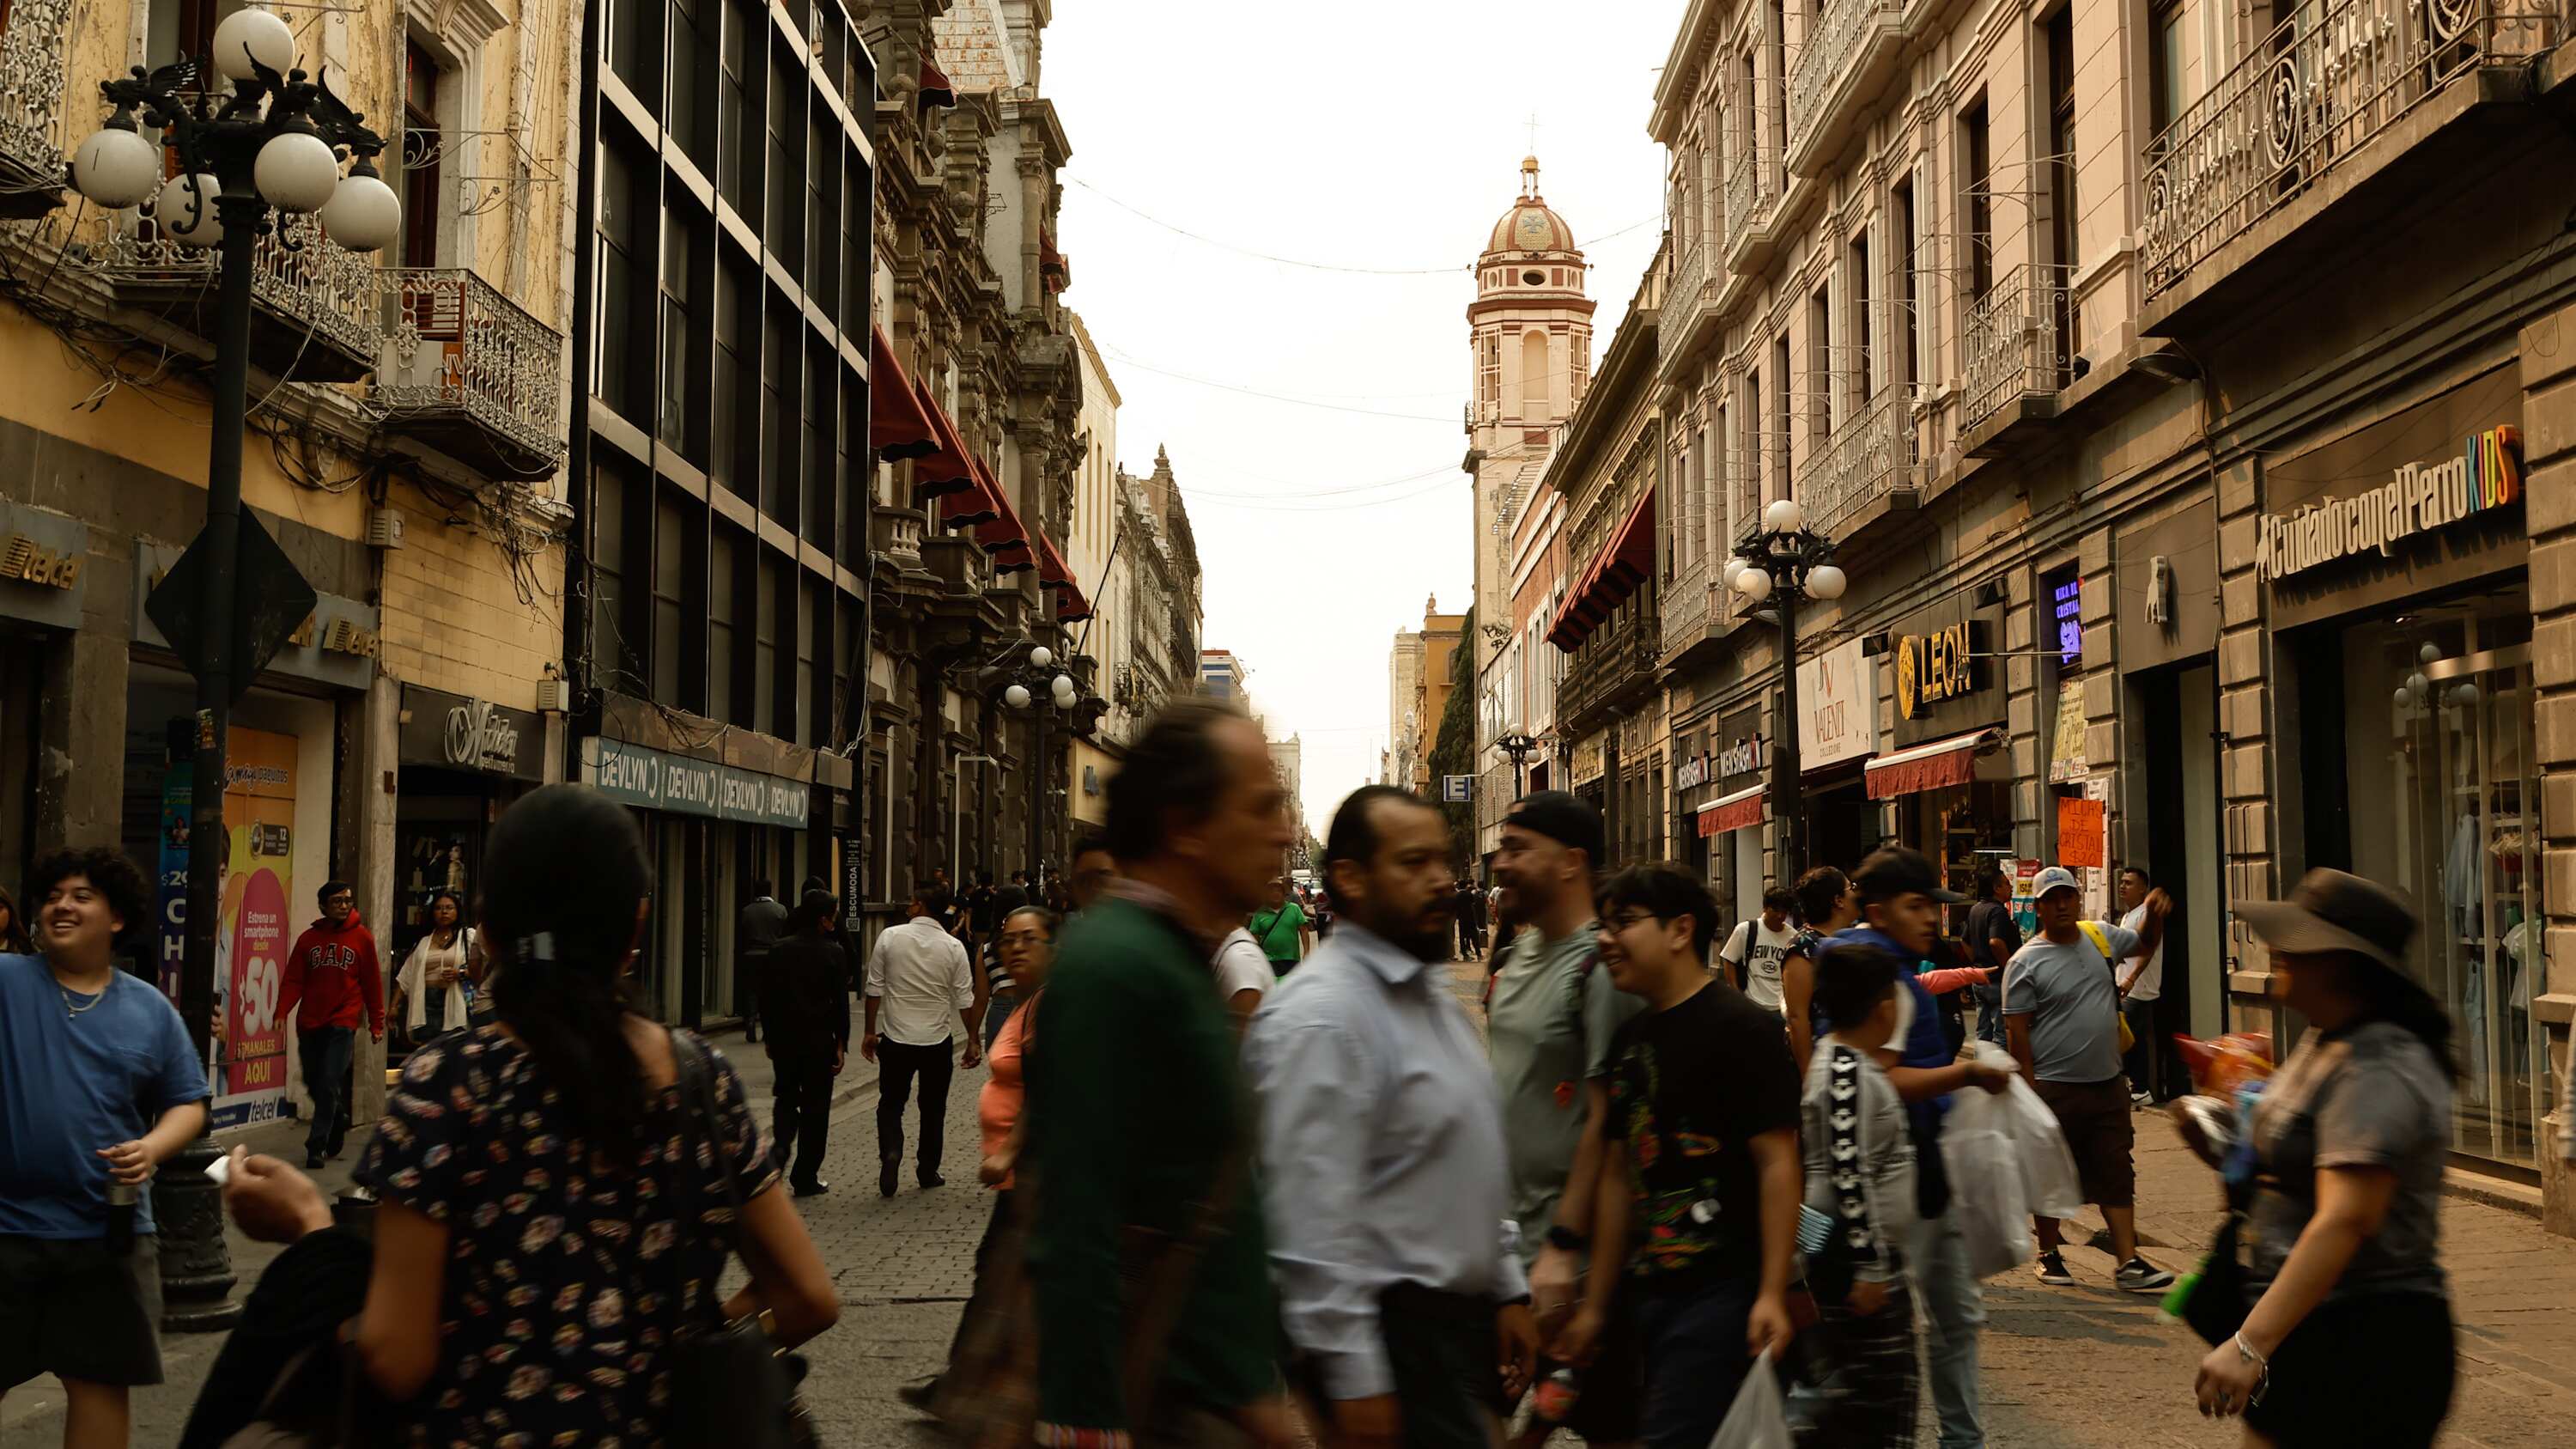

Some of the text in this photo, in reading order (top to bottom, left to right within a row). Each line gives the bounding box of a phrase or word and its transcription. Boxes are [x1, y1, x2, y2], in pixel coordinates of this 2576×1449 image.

[2467, 424, 2518, 514] KIDS
[1921, 619, 1971, 703] LEON
[1814, 700, 1844, 744] VALENTI
[601, 751, 647, 793] DEVLYN
[667, 766, 708, 803] DEVLYN
[1449, 777, 1465, 796] E
[723, 778, 757, 812] DEVLYN
[771, 787, 799, 817] DEVLYN
[2070, 819, 2089, 832] DE
[2060, 831, 2102, 853] CRISTAL
[2069, 849, 2097, 866] $20
[244, 925, 279, 941] smartphone
[270, 913, 276, 924] un
[309, 942, 355, 971] GAP
[1754, 945, 1786, 961] EW YO
[240, 956, 281, 1037] $50
[250, 1098, 276, 1122] telcel
